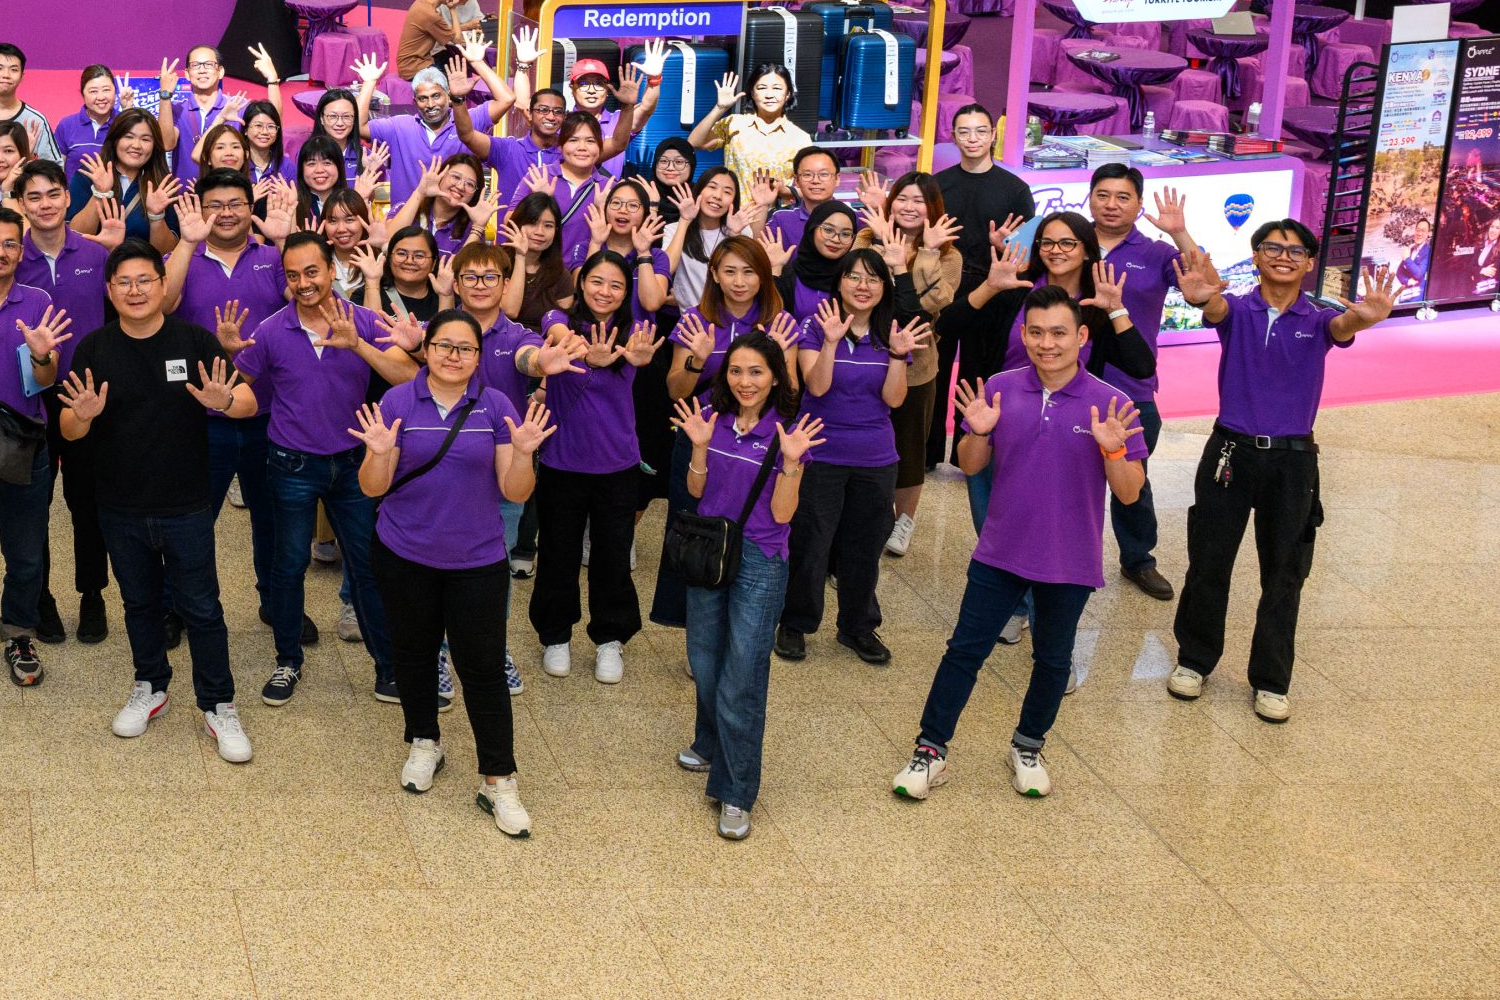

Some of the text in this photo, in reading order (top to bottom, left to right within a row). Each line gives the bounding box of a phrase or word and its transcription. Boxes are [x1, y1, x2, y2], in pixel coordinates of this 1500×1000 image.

[583, 8, 711, 28] Redemption
[1388, 70, 1423, 83] KENYA
[1464, 66, 1500, 78] SYDNE
